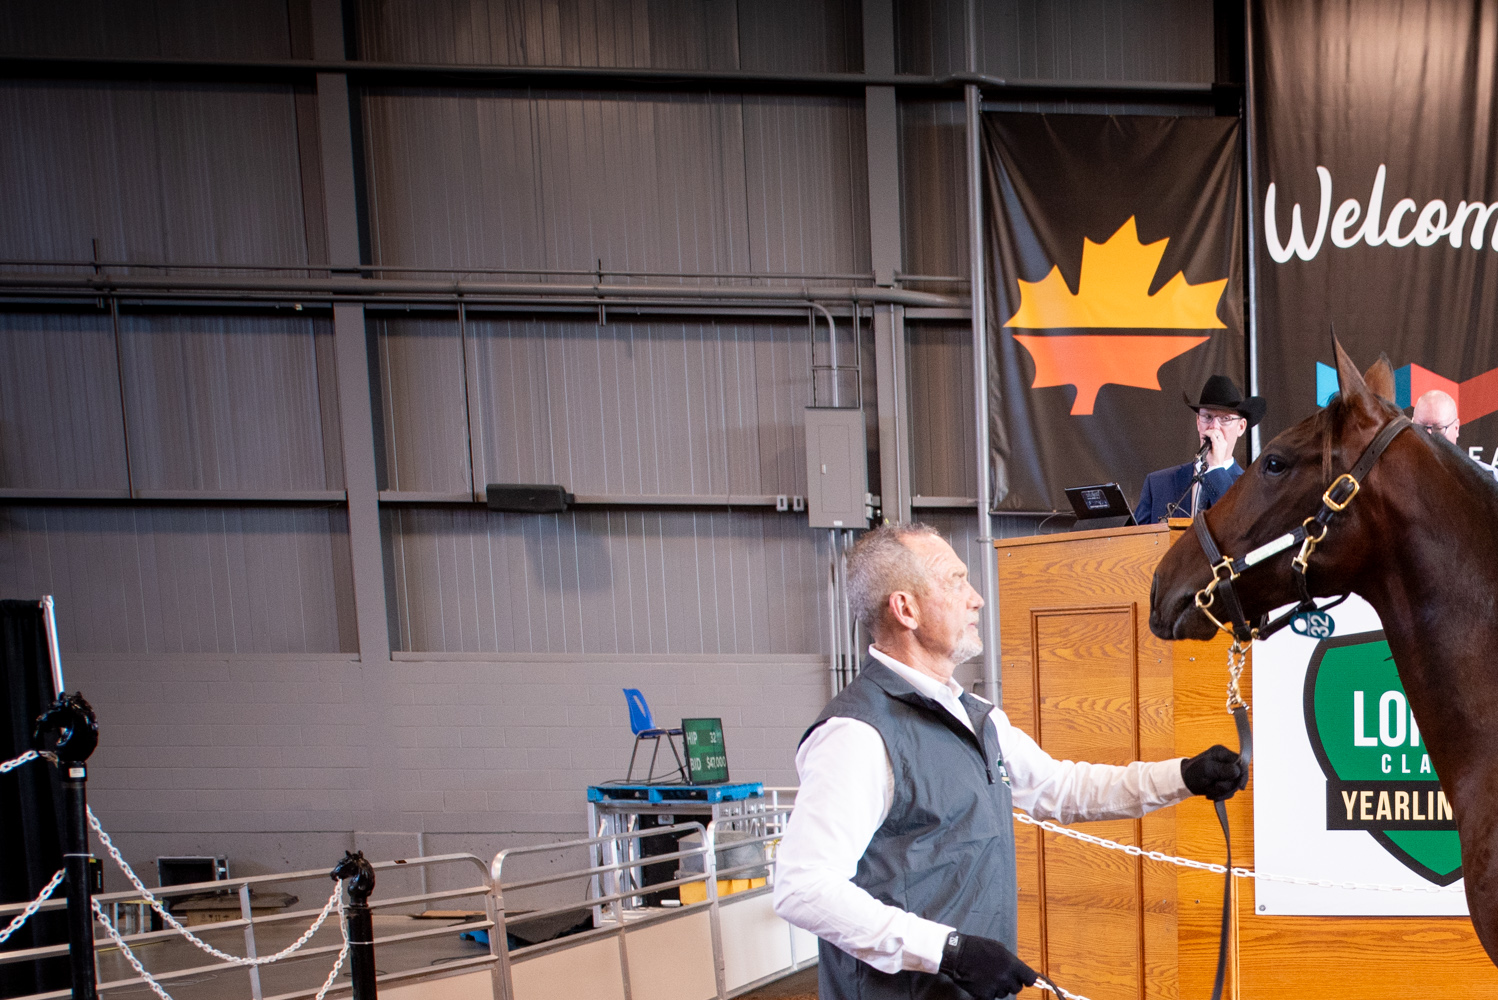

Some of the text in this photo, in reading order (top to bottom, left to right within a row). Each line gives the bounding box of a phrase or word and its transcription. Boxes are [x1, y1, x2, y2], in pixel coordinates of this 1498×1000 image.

[1310, 614, 1330, 638] 32
[686, 731, 717, 745] HIP 32
[690, 757, 702, 771] BID
